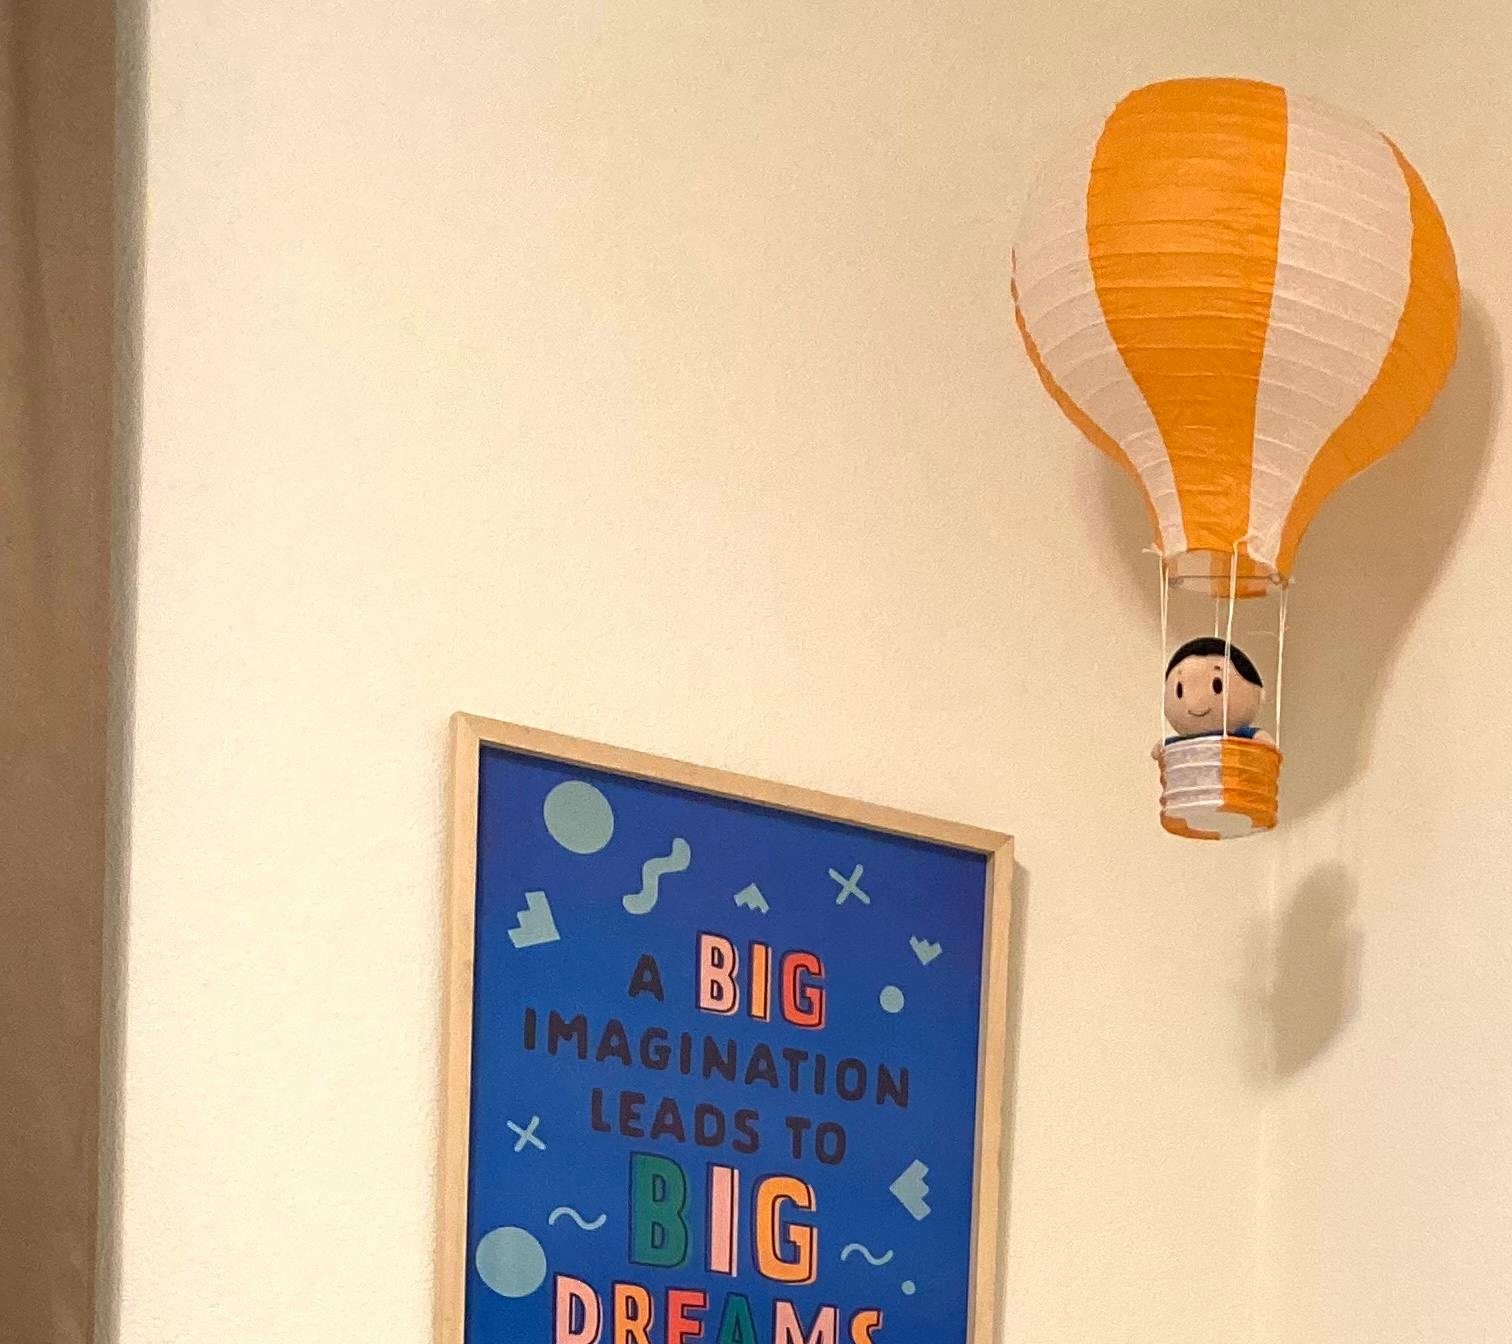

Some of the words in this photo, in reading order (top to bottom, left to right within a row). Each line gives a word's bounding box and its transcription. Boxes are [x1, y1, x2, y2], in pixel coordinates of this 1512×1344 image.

[629, 953, 665, 1002] A
[695, 931, 826, 1031] BIG
[522, 1007, 912, 1110] IMAGINATION
[589, 1089, 760, 1157] LEADS
[785, 1115, 848, 1167] TO
[629, 1151, 819, 1286] BIG
